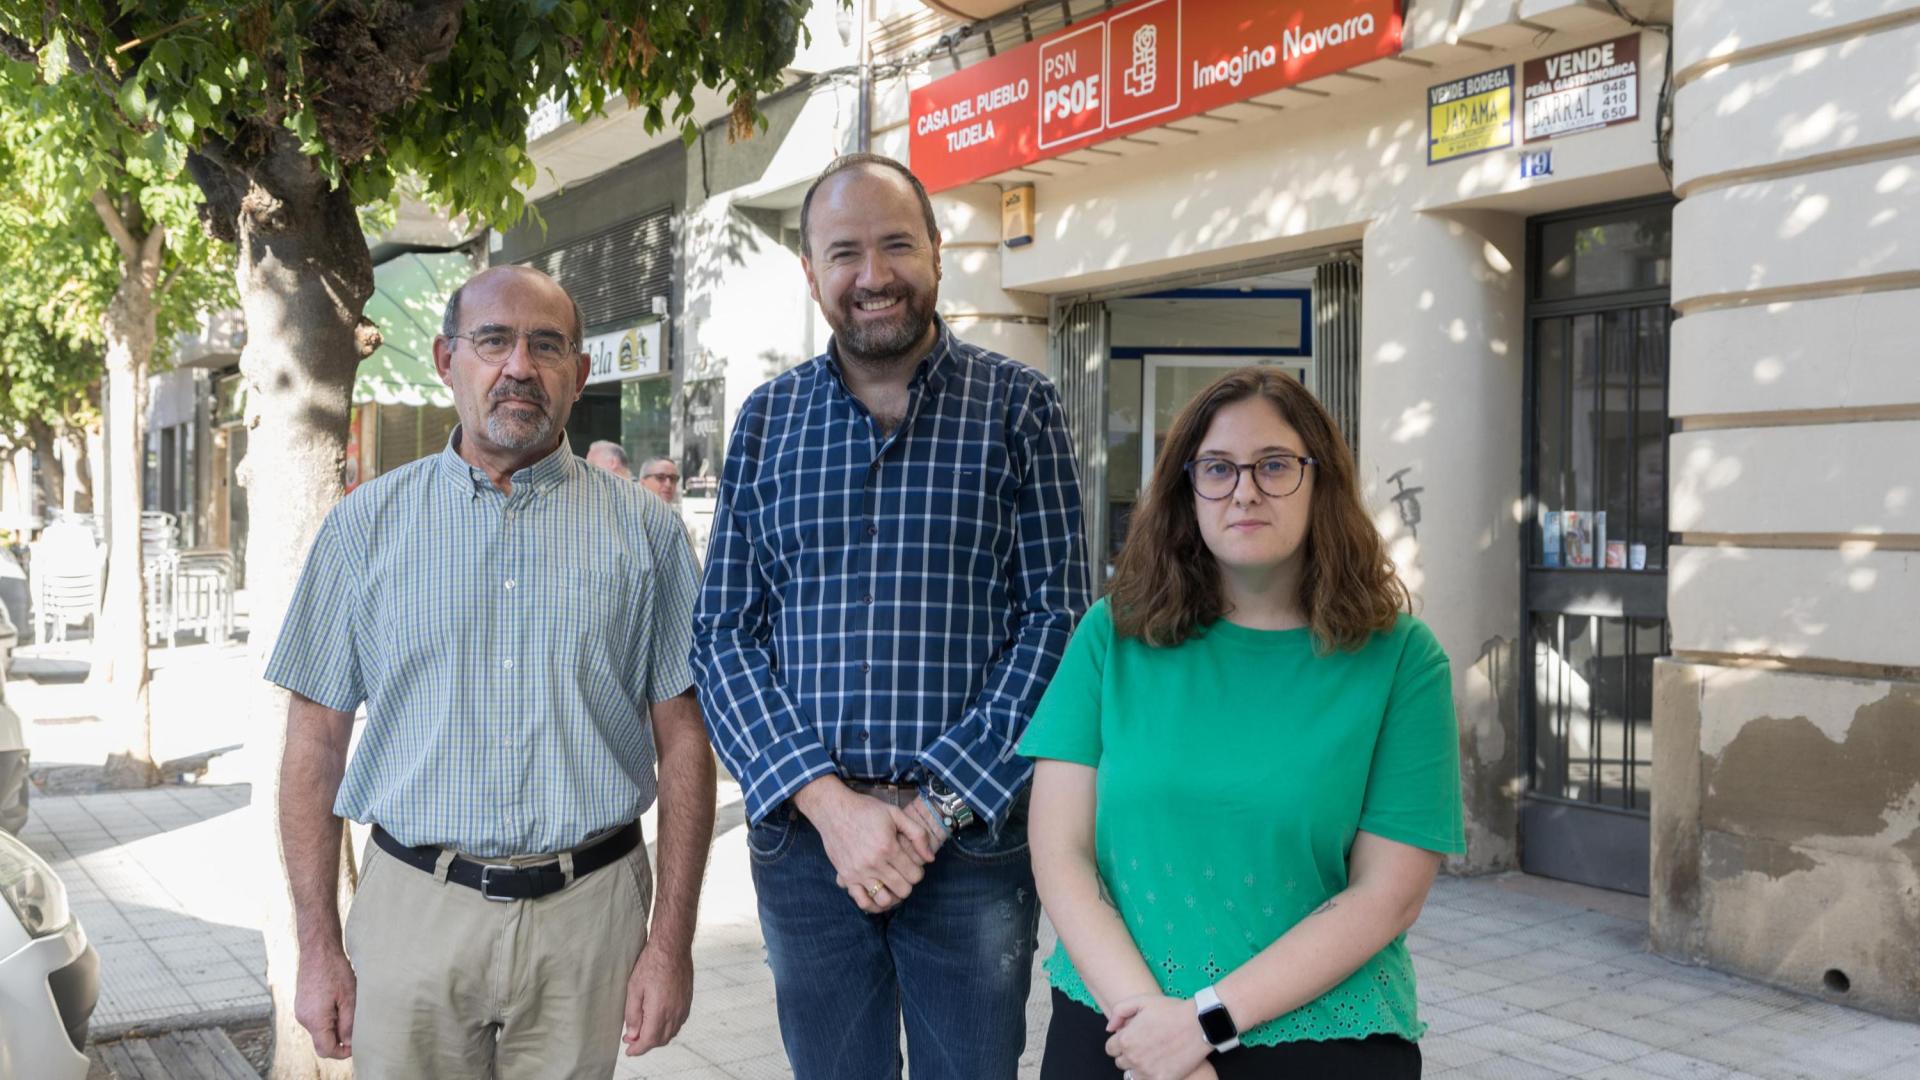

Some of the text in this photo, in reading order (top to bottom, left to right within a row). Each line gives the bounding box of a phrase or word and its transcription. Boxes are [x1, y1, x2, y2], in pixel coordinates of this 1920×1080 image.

[1045, 49, 1077, 83] PSN
[1193, 12, 1374, 90] Imagina Navarra
[1545, 42, 1615, 80] VENDE
[1431, 69, 1510, 104] VENDE BODEGA
[1525, 61, 1636, 98] PEÑA GASTRONOMICA
[1602, 79, 1627, 95] 948
[917, 78, 1029, 136] CASA DEL PUEBLO
[1044, 74, 1099, 124] PSOE
[1443, 99, 1498, 133] JARAMA
[1532, 88, 1595, 129] BARRAL
[1602, 105, 1627, 120] 650
[1603, 93, 1627, 107] 410
[946, 119, 995, 153] TUDELA
[1525, 152, 1549, 177] 19
